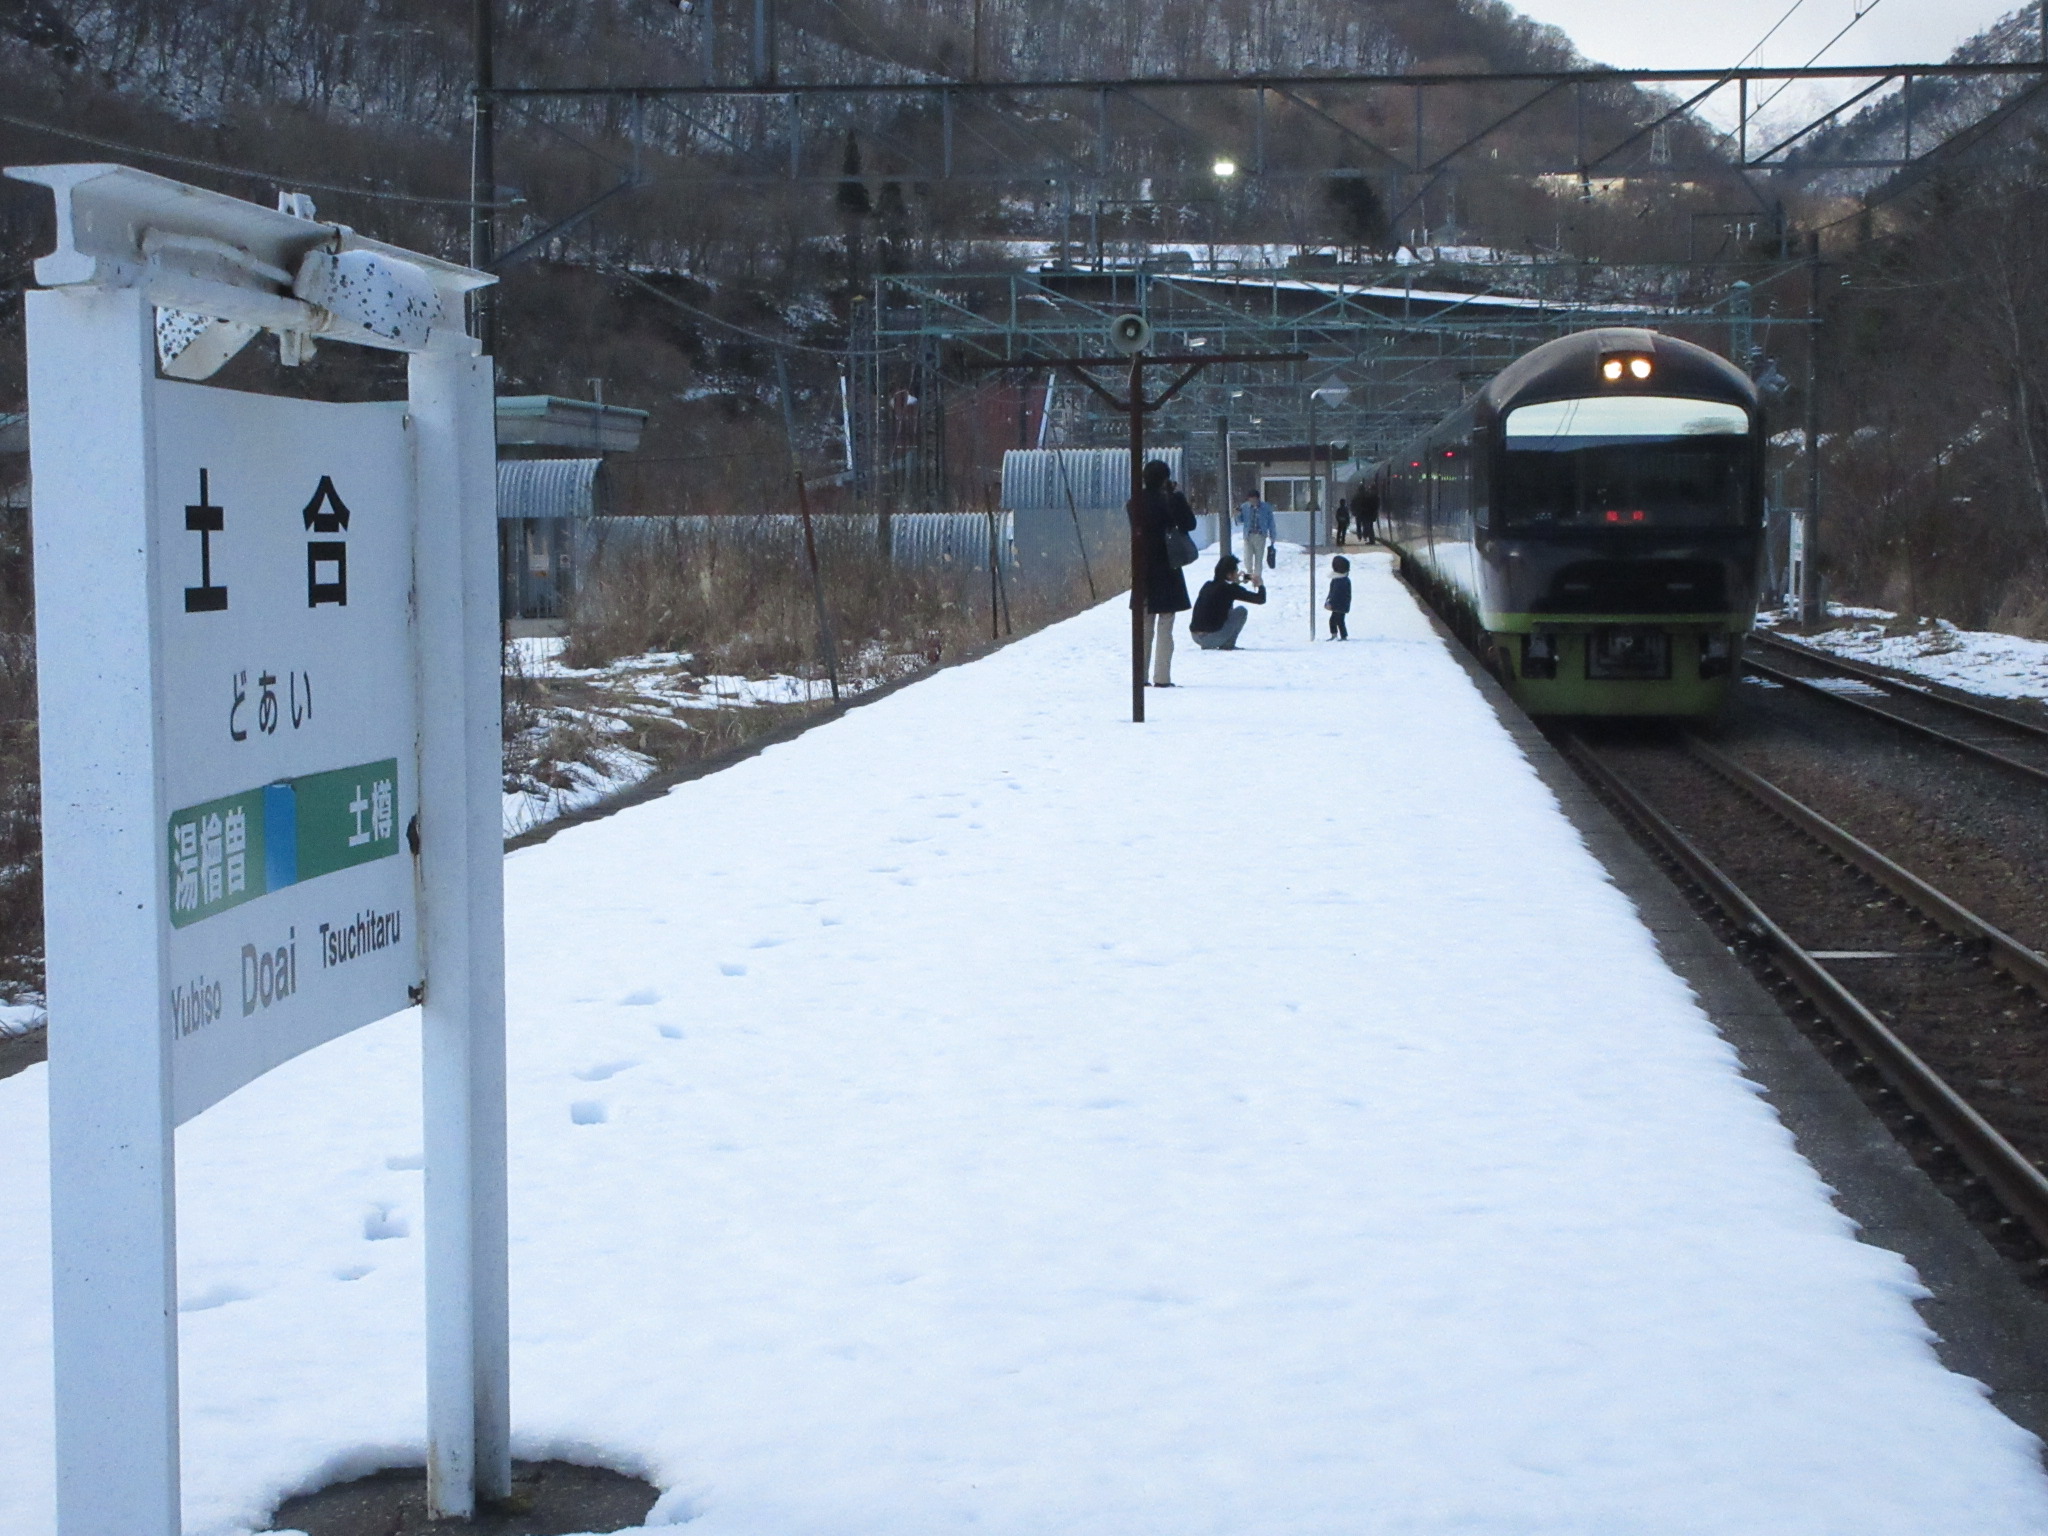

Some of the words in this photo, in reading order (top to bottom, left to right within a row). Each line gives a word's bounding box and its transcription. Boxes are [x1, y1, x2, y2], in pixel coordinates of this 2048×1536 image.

[184, 467, 350, 613] 土合
[230, 670, 312, 741] どあい
[348, 779, 393, 848] 土樽
[241, 926, 296, 1018] Doai
[319, 909, 401, 968] Tsuchitaru
[171, 975, 222, 1040] Yubiso
